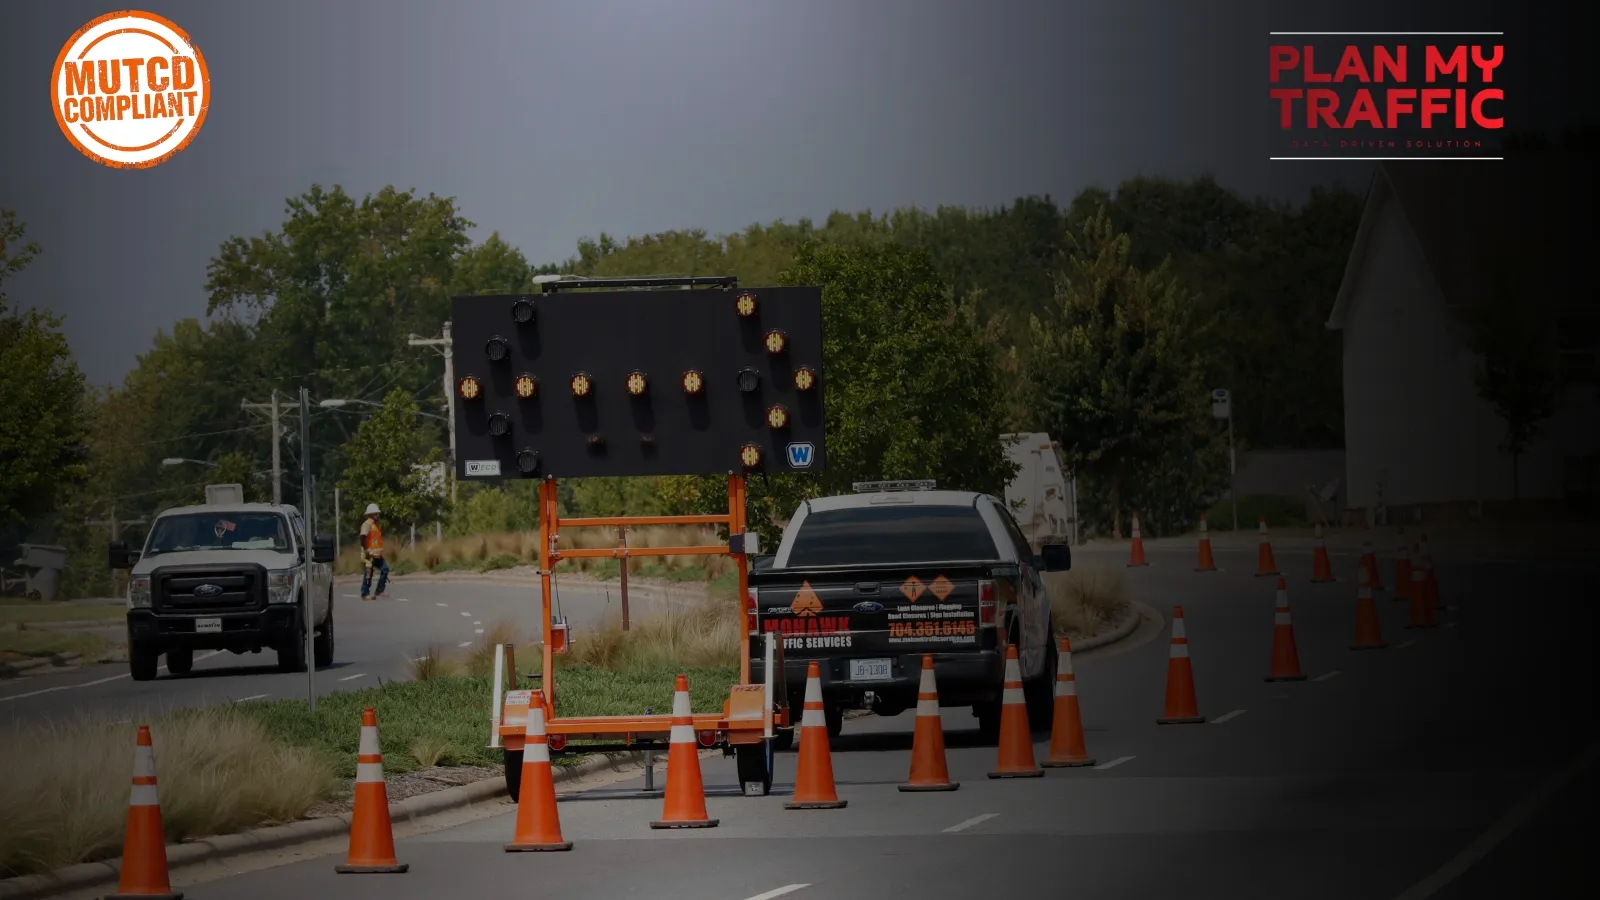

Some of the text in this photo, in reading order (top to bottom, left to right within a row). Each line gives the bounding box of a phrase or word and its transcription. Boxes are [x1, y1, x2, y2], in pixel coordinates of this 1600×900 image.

[911, 603, 935, 611] Closures
[930, 611, 943, 619] Sign
[763, 616, 850, 638] MOHAWK
[806, 636, 852, 649] SERVICES
